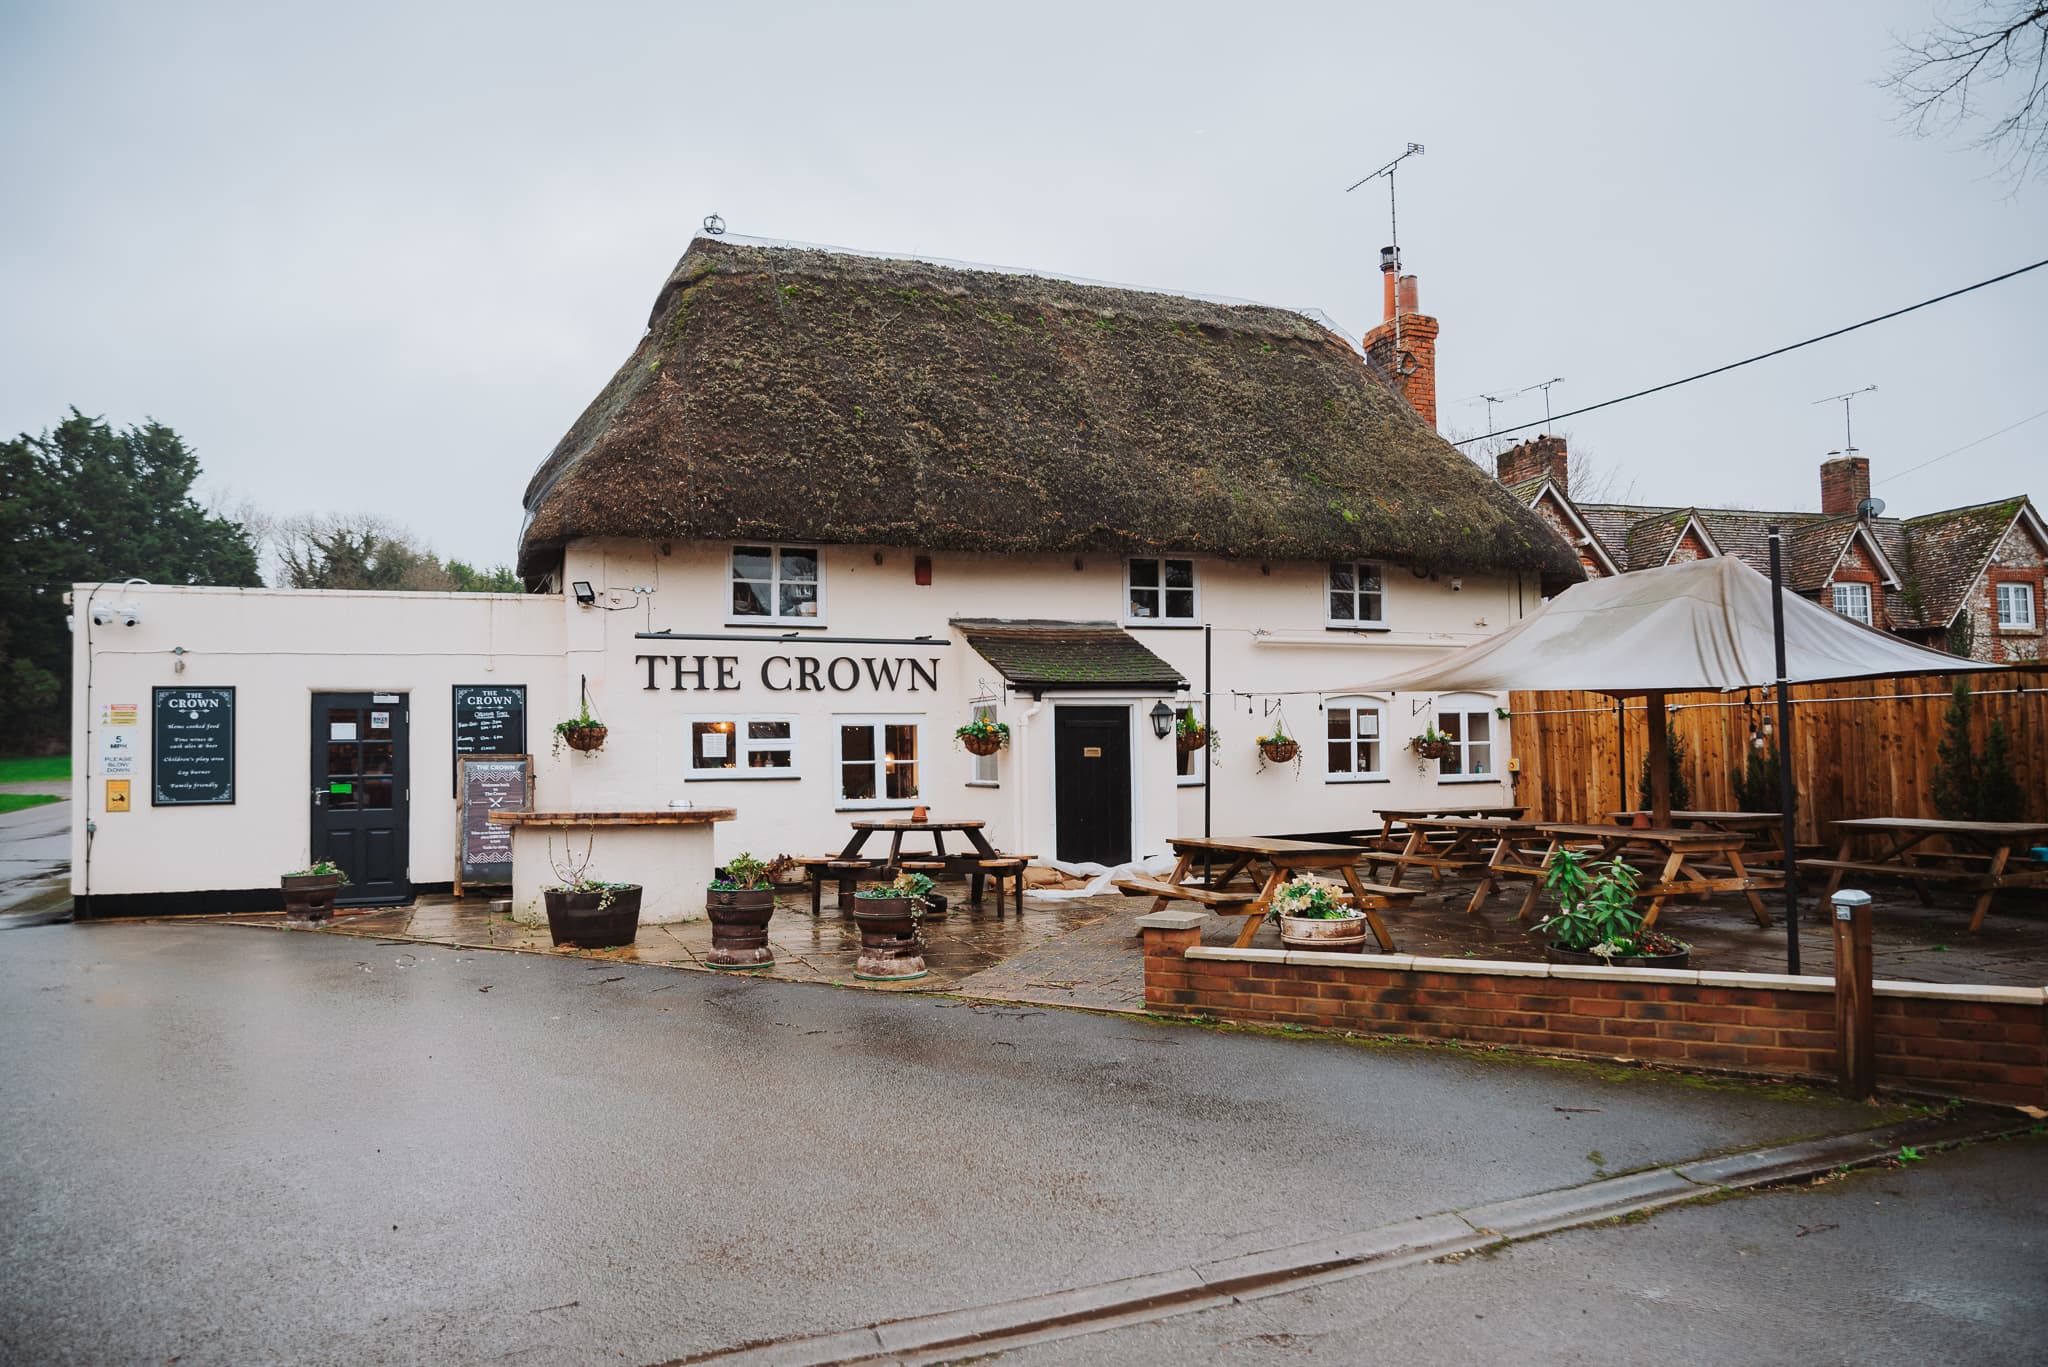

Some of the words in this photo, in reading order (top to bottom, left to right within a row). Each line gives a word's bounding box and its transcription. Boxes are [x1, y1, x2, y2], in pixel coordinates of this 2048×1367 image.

[635, 654, 741, 691] THE
[760, 655, 941, 692] CROWN
[168, 699, 219, 708] CROWN
[467, 697, 512, 705] CROWN
[115, 735, 122, 743] 5
